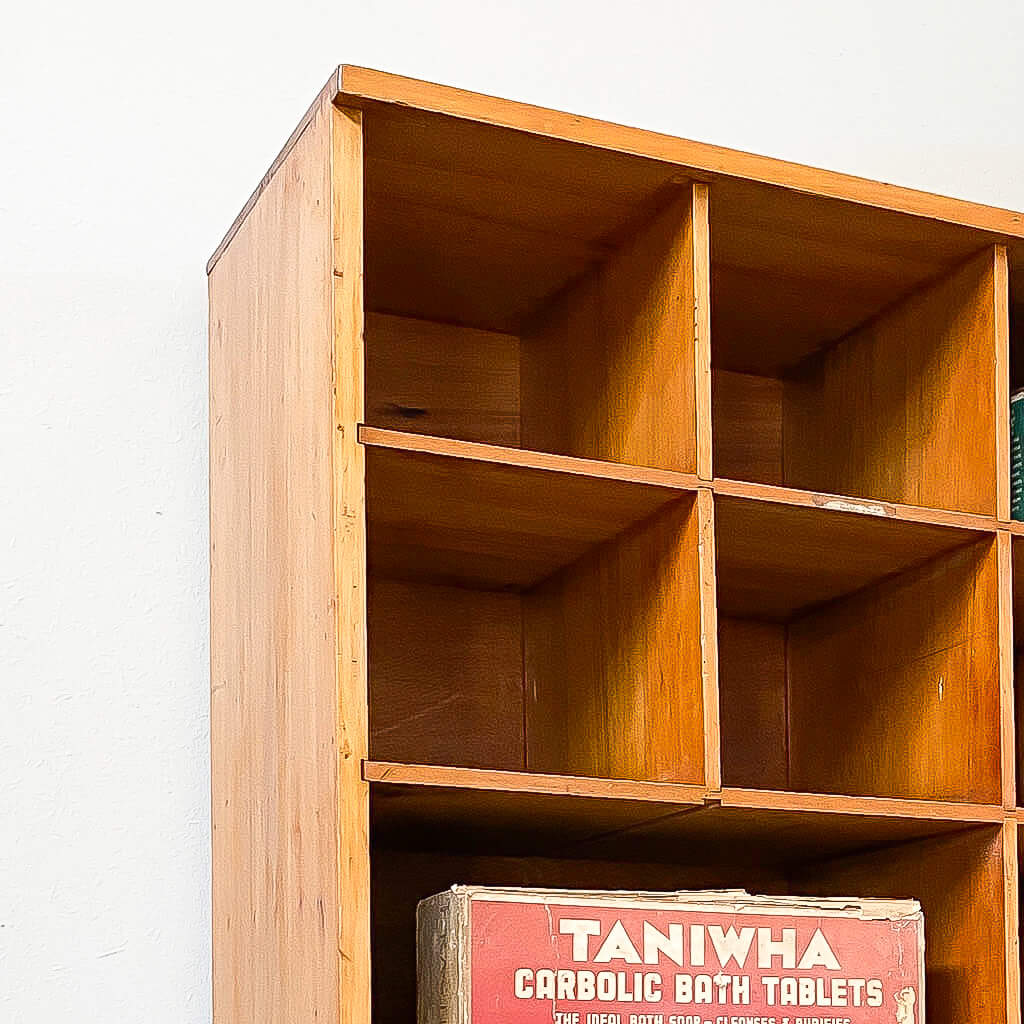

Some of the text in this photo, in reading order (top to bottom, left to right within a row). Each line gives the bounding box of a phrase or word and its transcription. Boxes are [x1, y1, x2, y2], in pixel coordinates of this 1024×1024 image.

[559, 918, 841, 970] TANIWHA
[514, 967, 884, 1007] CARBOLIC BATH TABLETS
